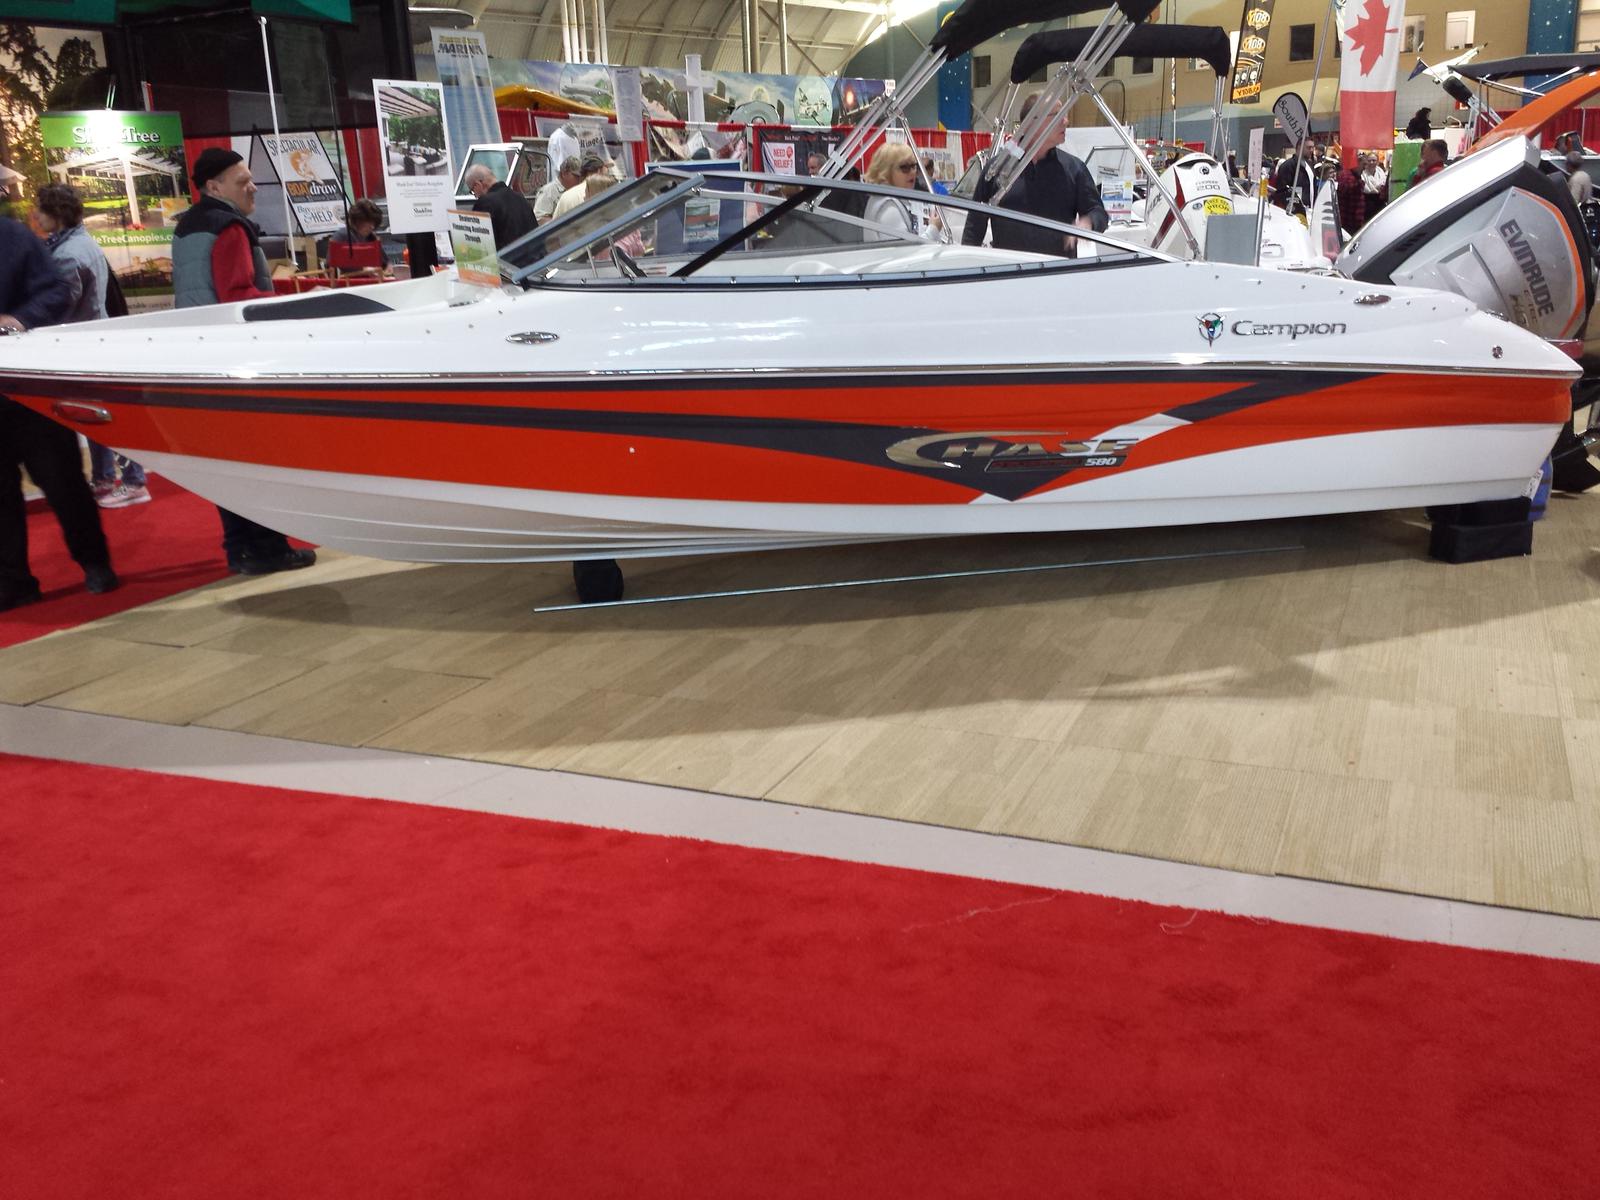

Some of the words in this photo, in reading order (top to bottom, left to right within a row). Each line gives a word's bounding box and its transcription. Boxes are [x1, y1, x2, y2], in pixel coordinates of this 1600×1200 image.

[1278, 99, 1298, 129] South
[772, 148, 786, 158] NEED
[773, 159, 794, 169] RELIEF?
[472, 225, 490, 235] Available
[464, 233, 482, 243] Through
[1500, 218, 1555, 317] EVINRUDE
[1231, 320, 1347, 340] Campion
[1084, 456, 1117, 467] 580
